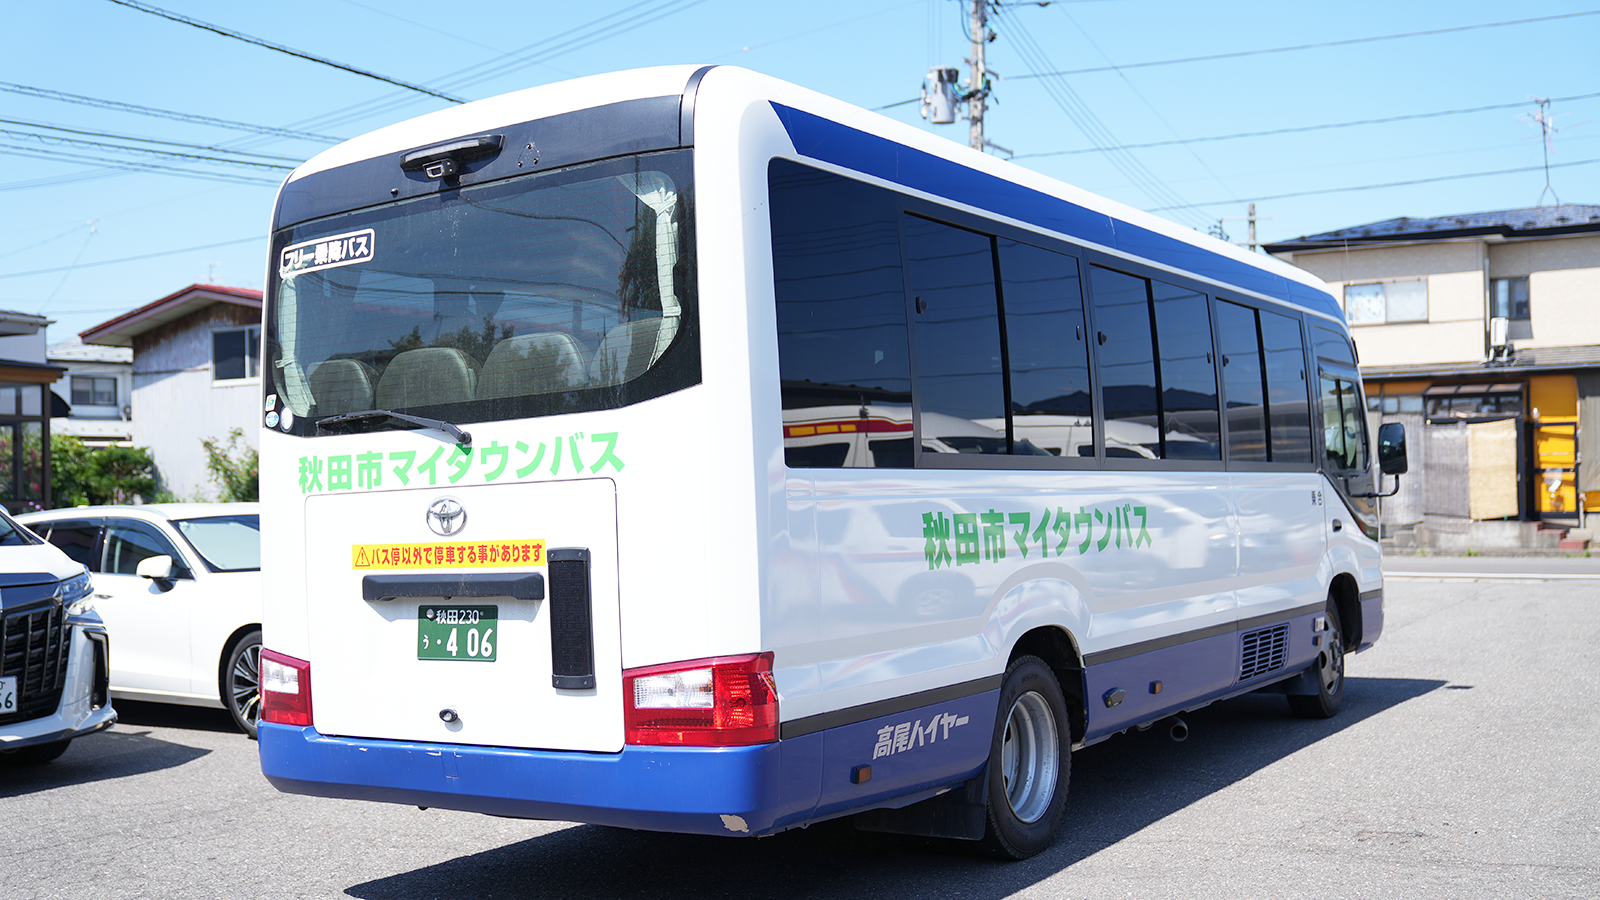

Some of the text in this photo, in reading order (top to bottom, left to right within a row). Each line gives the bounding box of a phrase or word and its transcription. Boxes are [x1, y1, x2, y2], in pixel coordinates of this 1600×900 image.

[299, 431, 625, 493] 秋田市マイタウンバス
[371, 543, 542, 566] バス停以外で停車する事があります
[921, 503, 1152, 571] 秋田市マイタウンバス
[872, 712, 970, 760] 高尾ハイヤー
